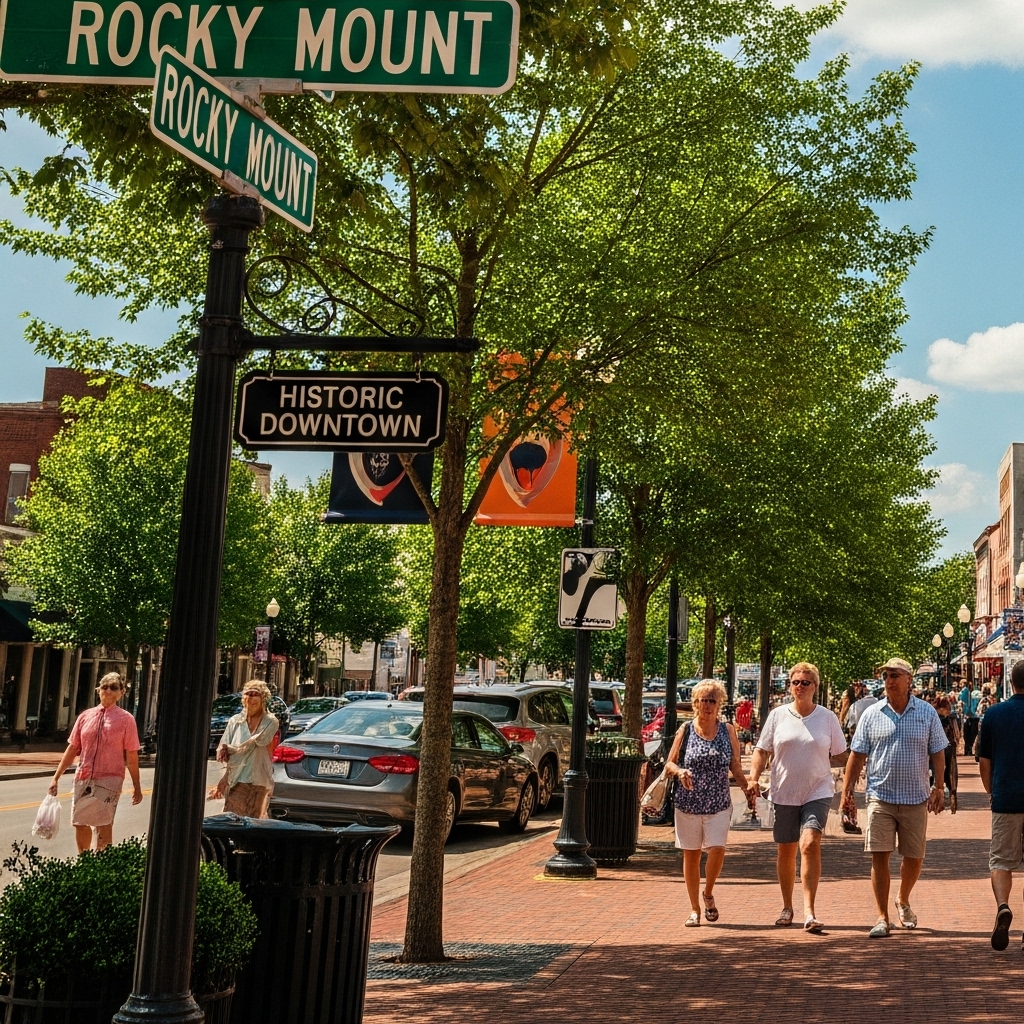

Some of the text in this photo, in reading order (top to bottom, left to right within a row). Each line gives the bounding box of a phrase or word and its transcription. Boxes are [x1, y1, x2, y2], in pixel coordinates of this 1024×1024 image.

[66, 0, 493, 76] ROCKY MOUNT
[160, 62, 313, 217] ROCKY MOUNT
[279, 384, 404, 410] HISTORIC
[259, 412, 422, 438] DOWNTOWN
